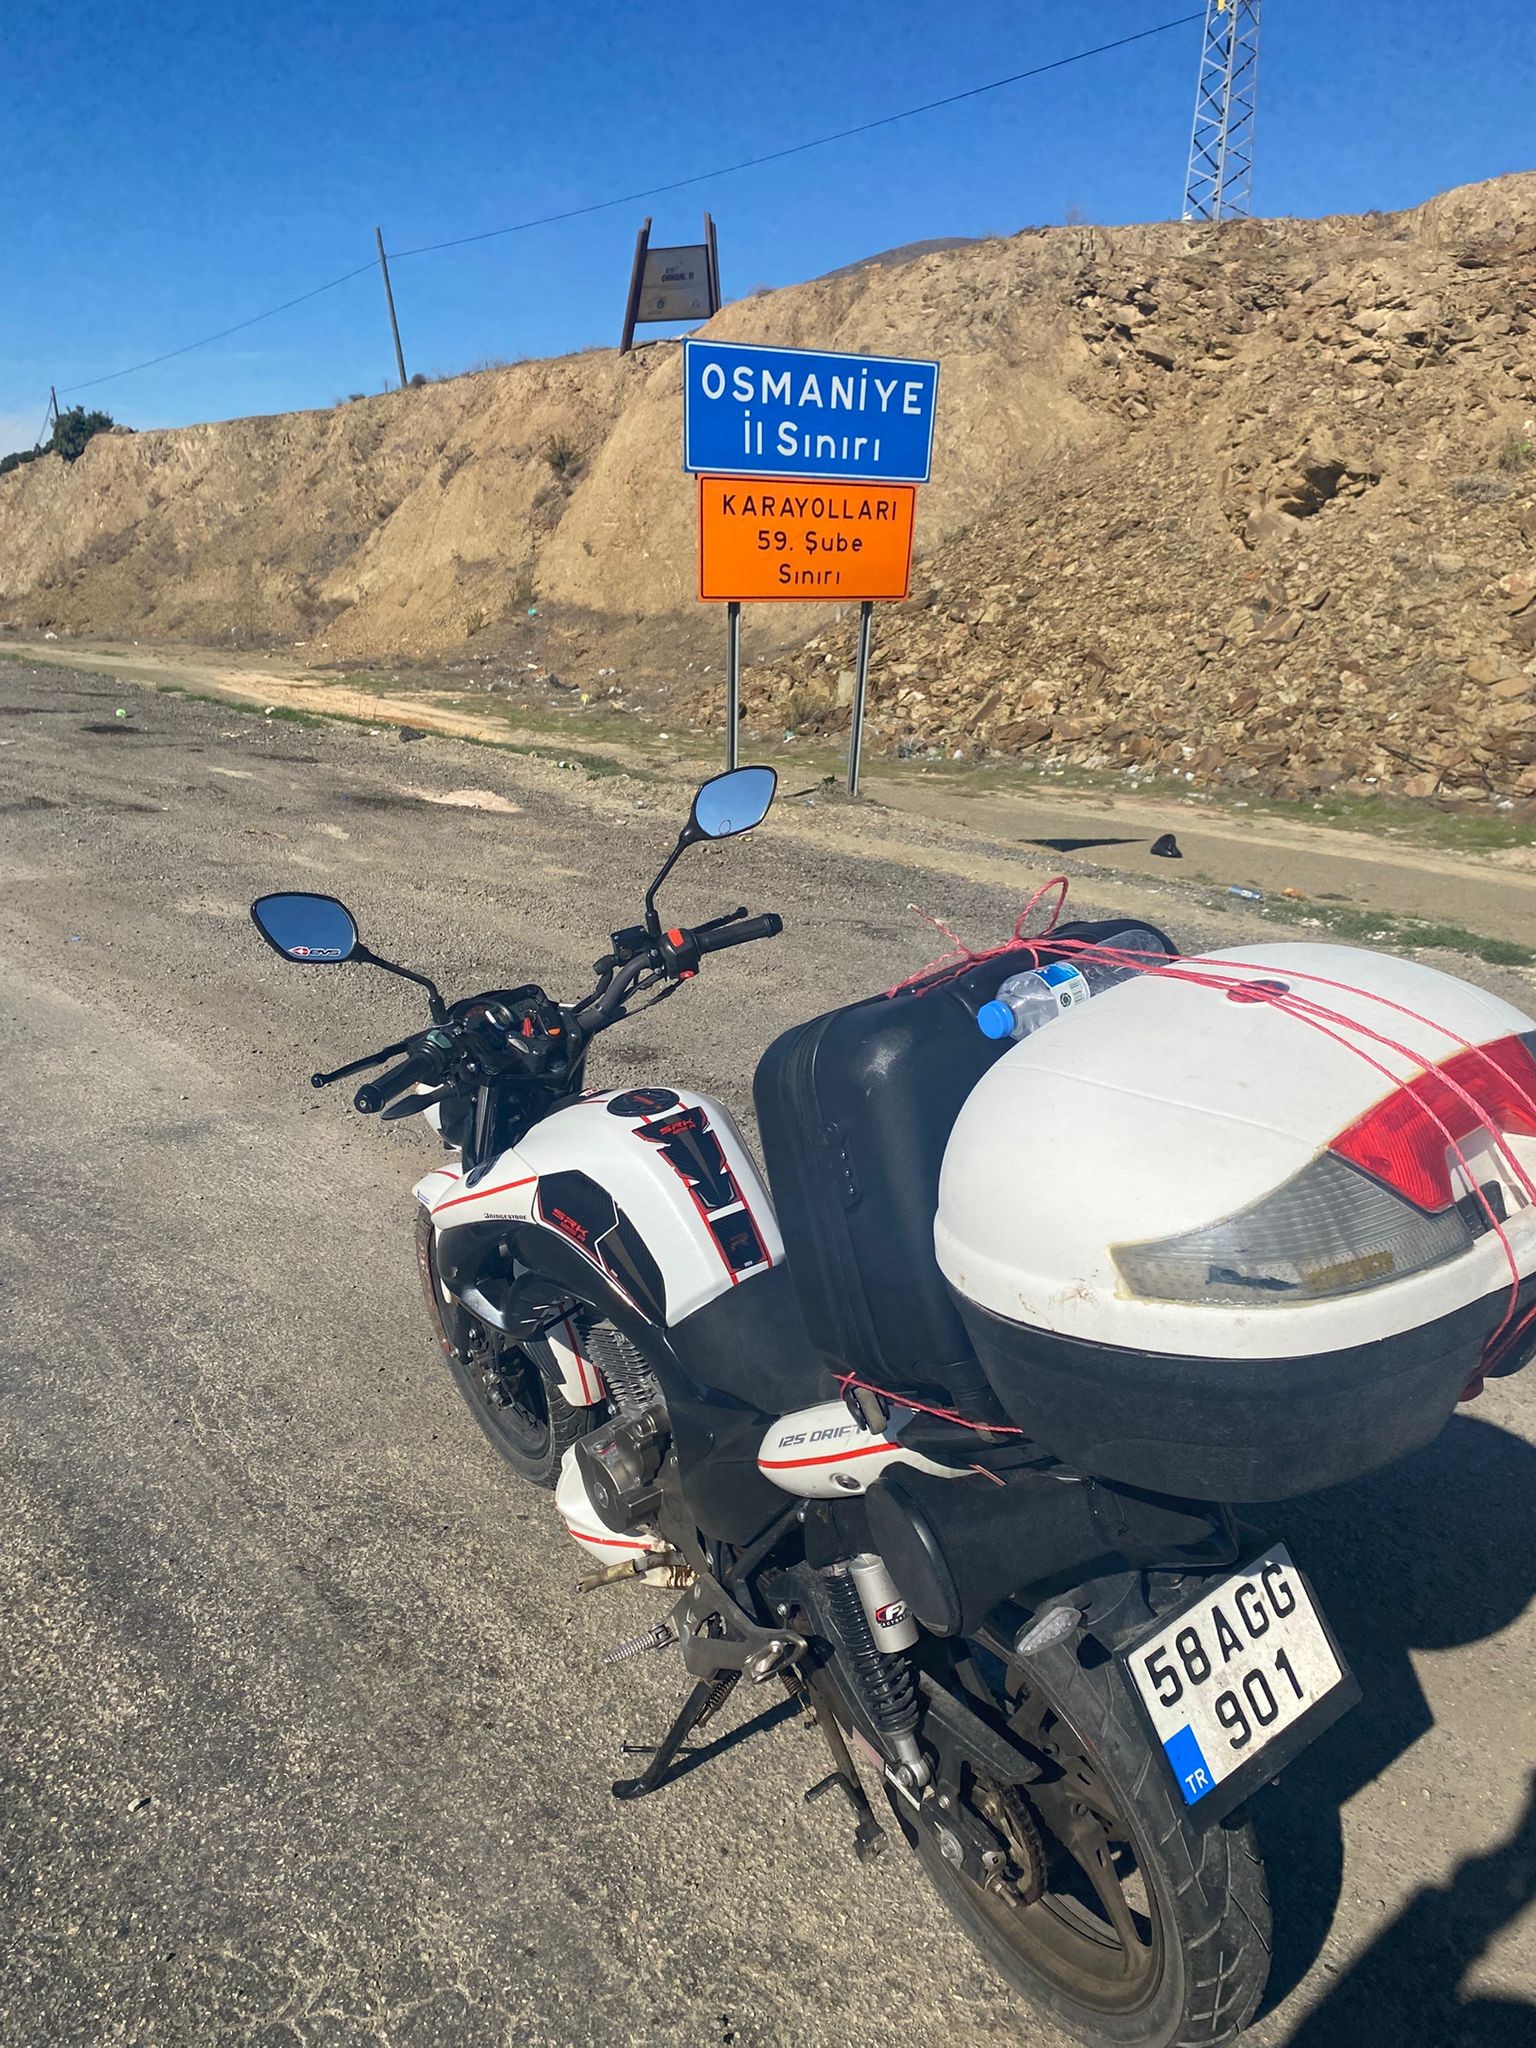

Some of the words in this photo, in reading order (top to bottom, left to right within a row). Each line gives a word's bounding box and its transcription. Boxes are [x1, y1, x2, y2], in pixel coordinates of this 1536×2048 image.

[701, 363, 924, 415] OSMANİYE
[744, 409, 763, 455] İl
[776, 421, 880, 462] Sınırı
[722, 494, 897, 521] KARAYOLLARI
[757, 530, 794, 552] 59.
[805, 531, 863, 555] Şube
[778, 563, 841, 585] Sınırı
[552, 1208, 588, 1238] SRK
[778, 1433, 806, 1448] 125
[1144, 1626, 1212, 1708] 58
[1211, 1563, 1296, 1663] AGG
[1214, 1647, 1304, 1750] 901
[1184, 1768, 1209, 1795] TR
